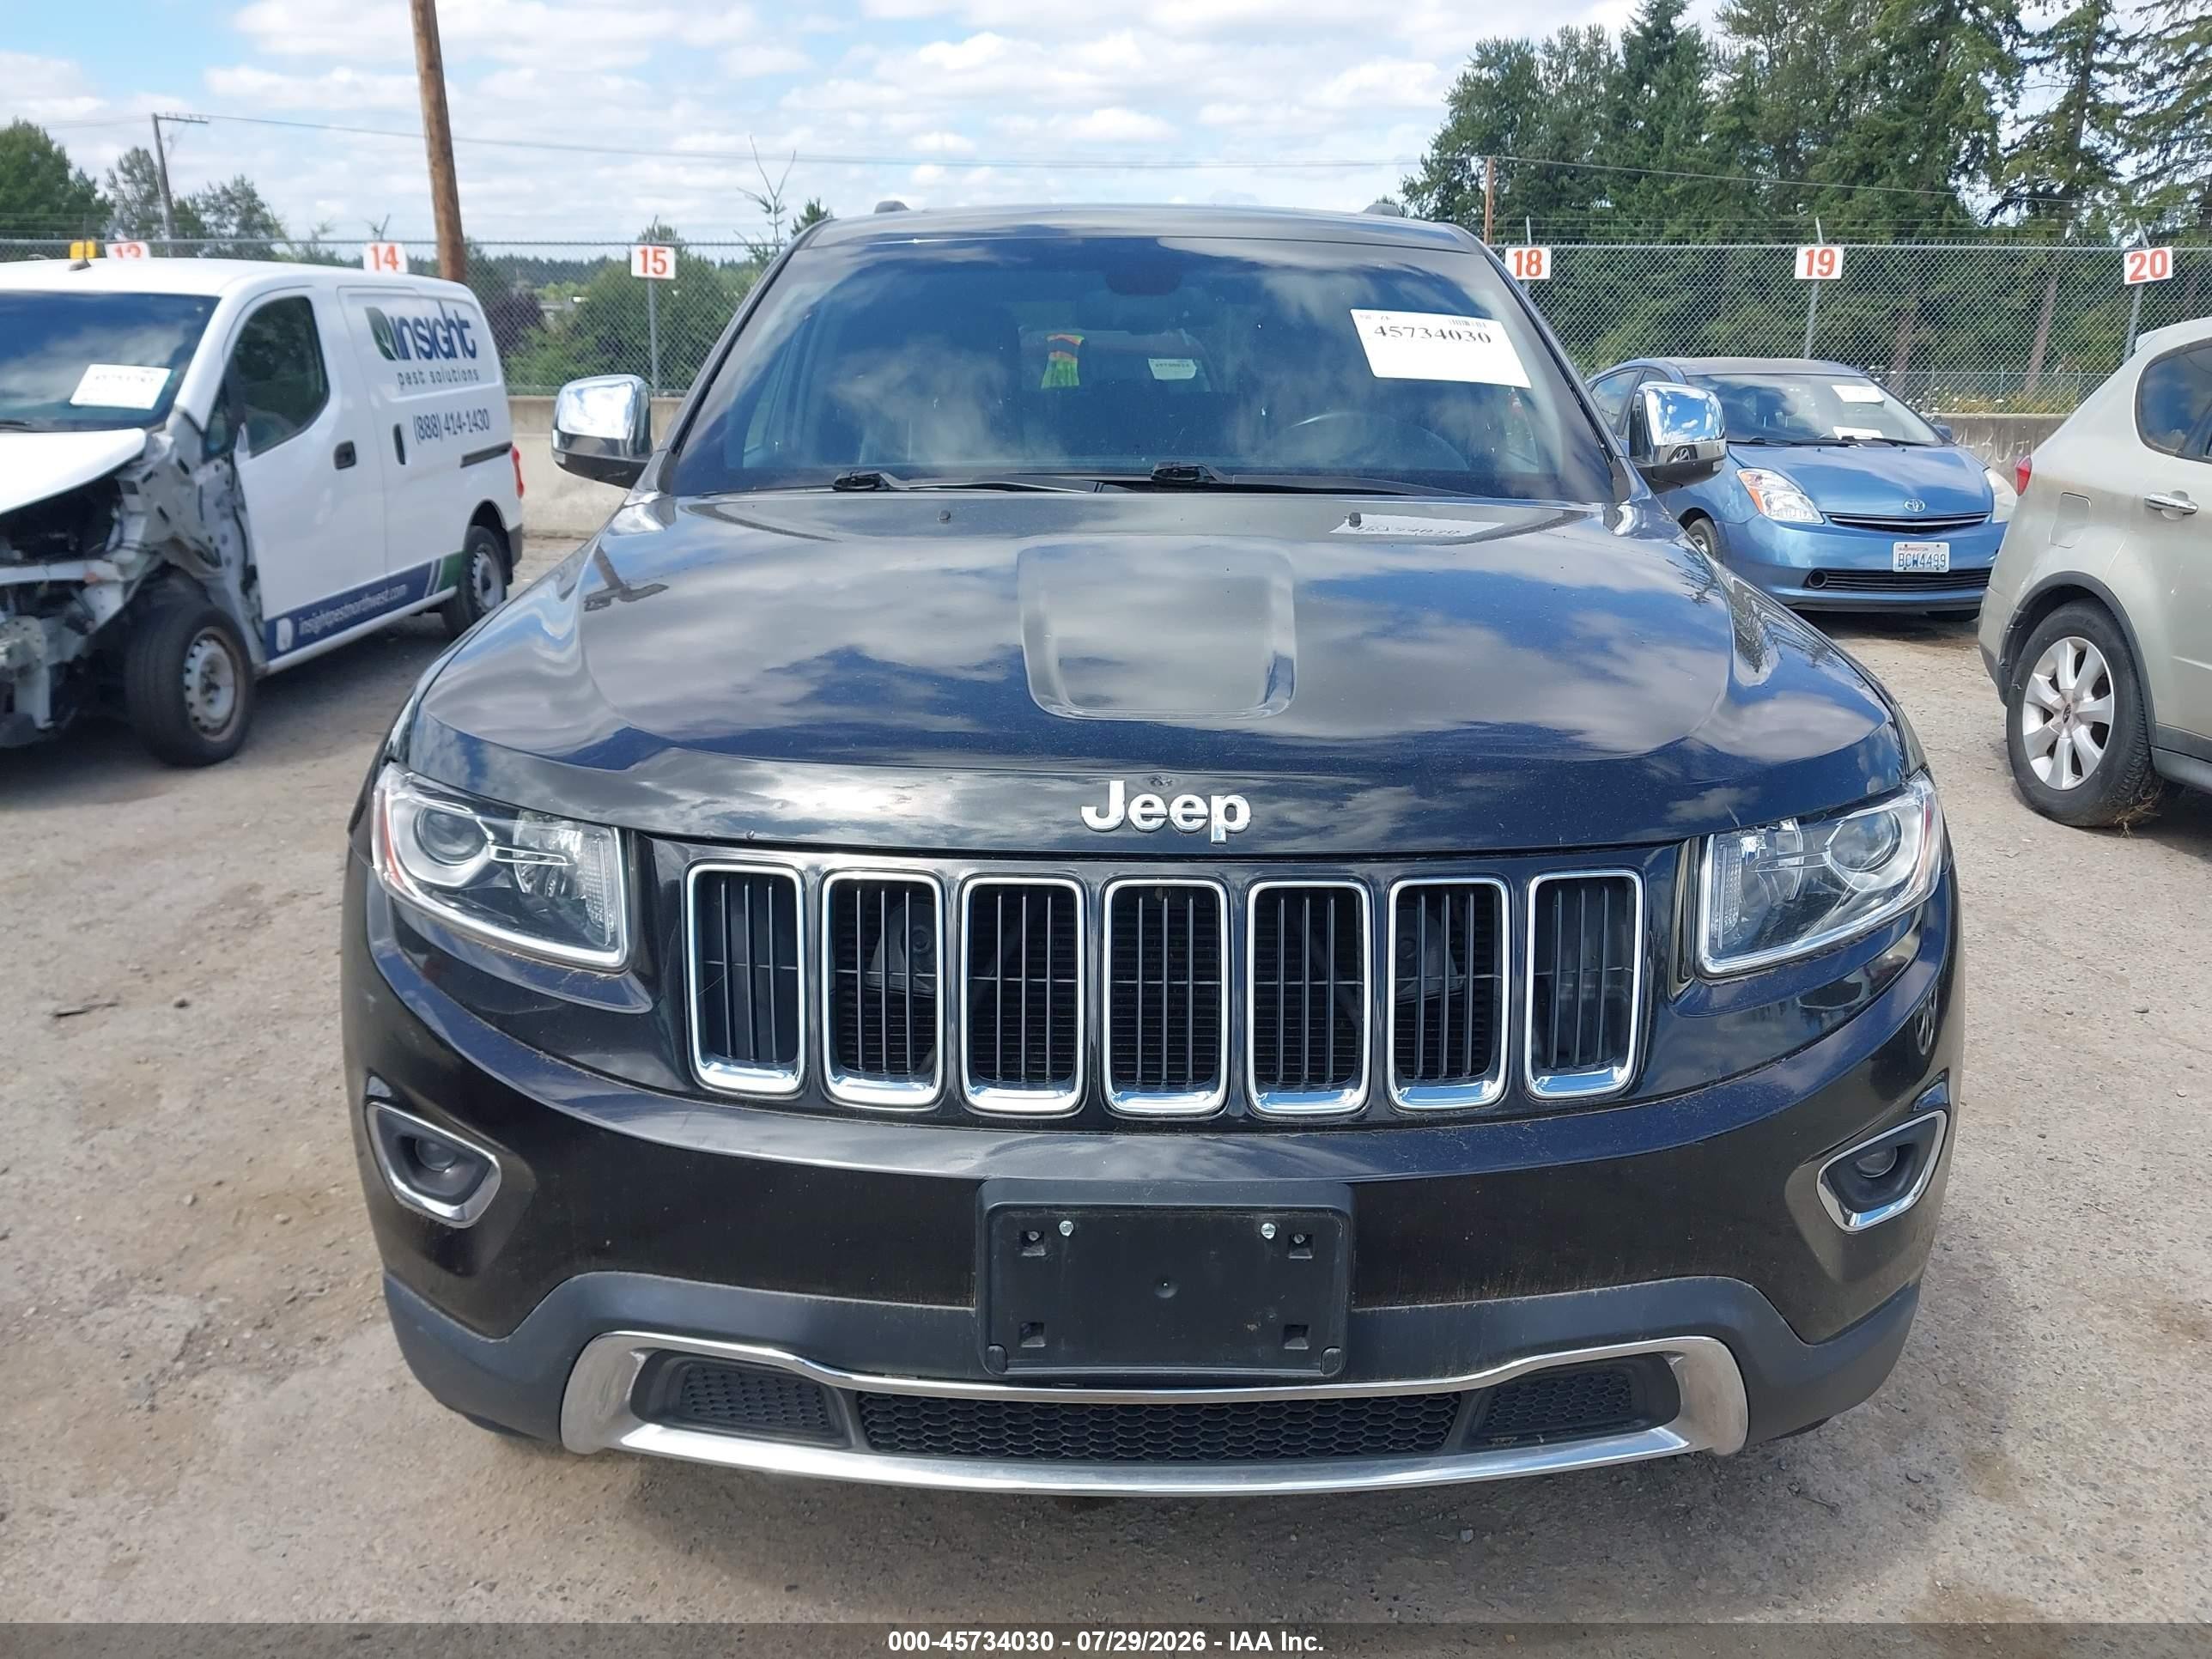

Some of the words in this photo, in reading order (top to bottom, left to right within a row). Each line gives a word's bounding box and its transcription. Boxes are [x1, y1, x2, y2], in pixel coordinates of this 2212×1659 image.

[370, 245, 399, 272] 14
[639, 246, 666, 275] 15
[1514, 249, 1542, 276] 18
[1806, 248, 1836, 276] 19
[2129, 249, 2168, 282] 20
[1374, 325, 1492, 344] 45734030
[398, 369, 426, 390] pest
[429, 367, 479, 384] solutions
[413, 413, 443, 445] (888)
[444, 408, 490, 436] 414-1430
[1898, 553, 1946, 568] BCW4499
[1081, 780, 1252, 844] Jeep
